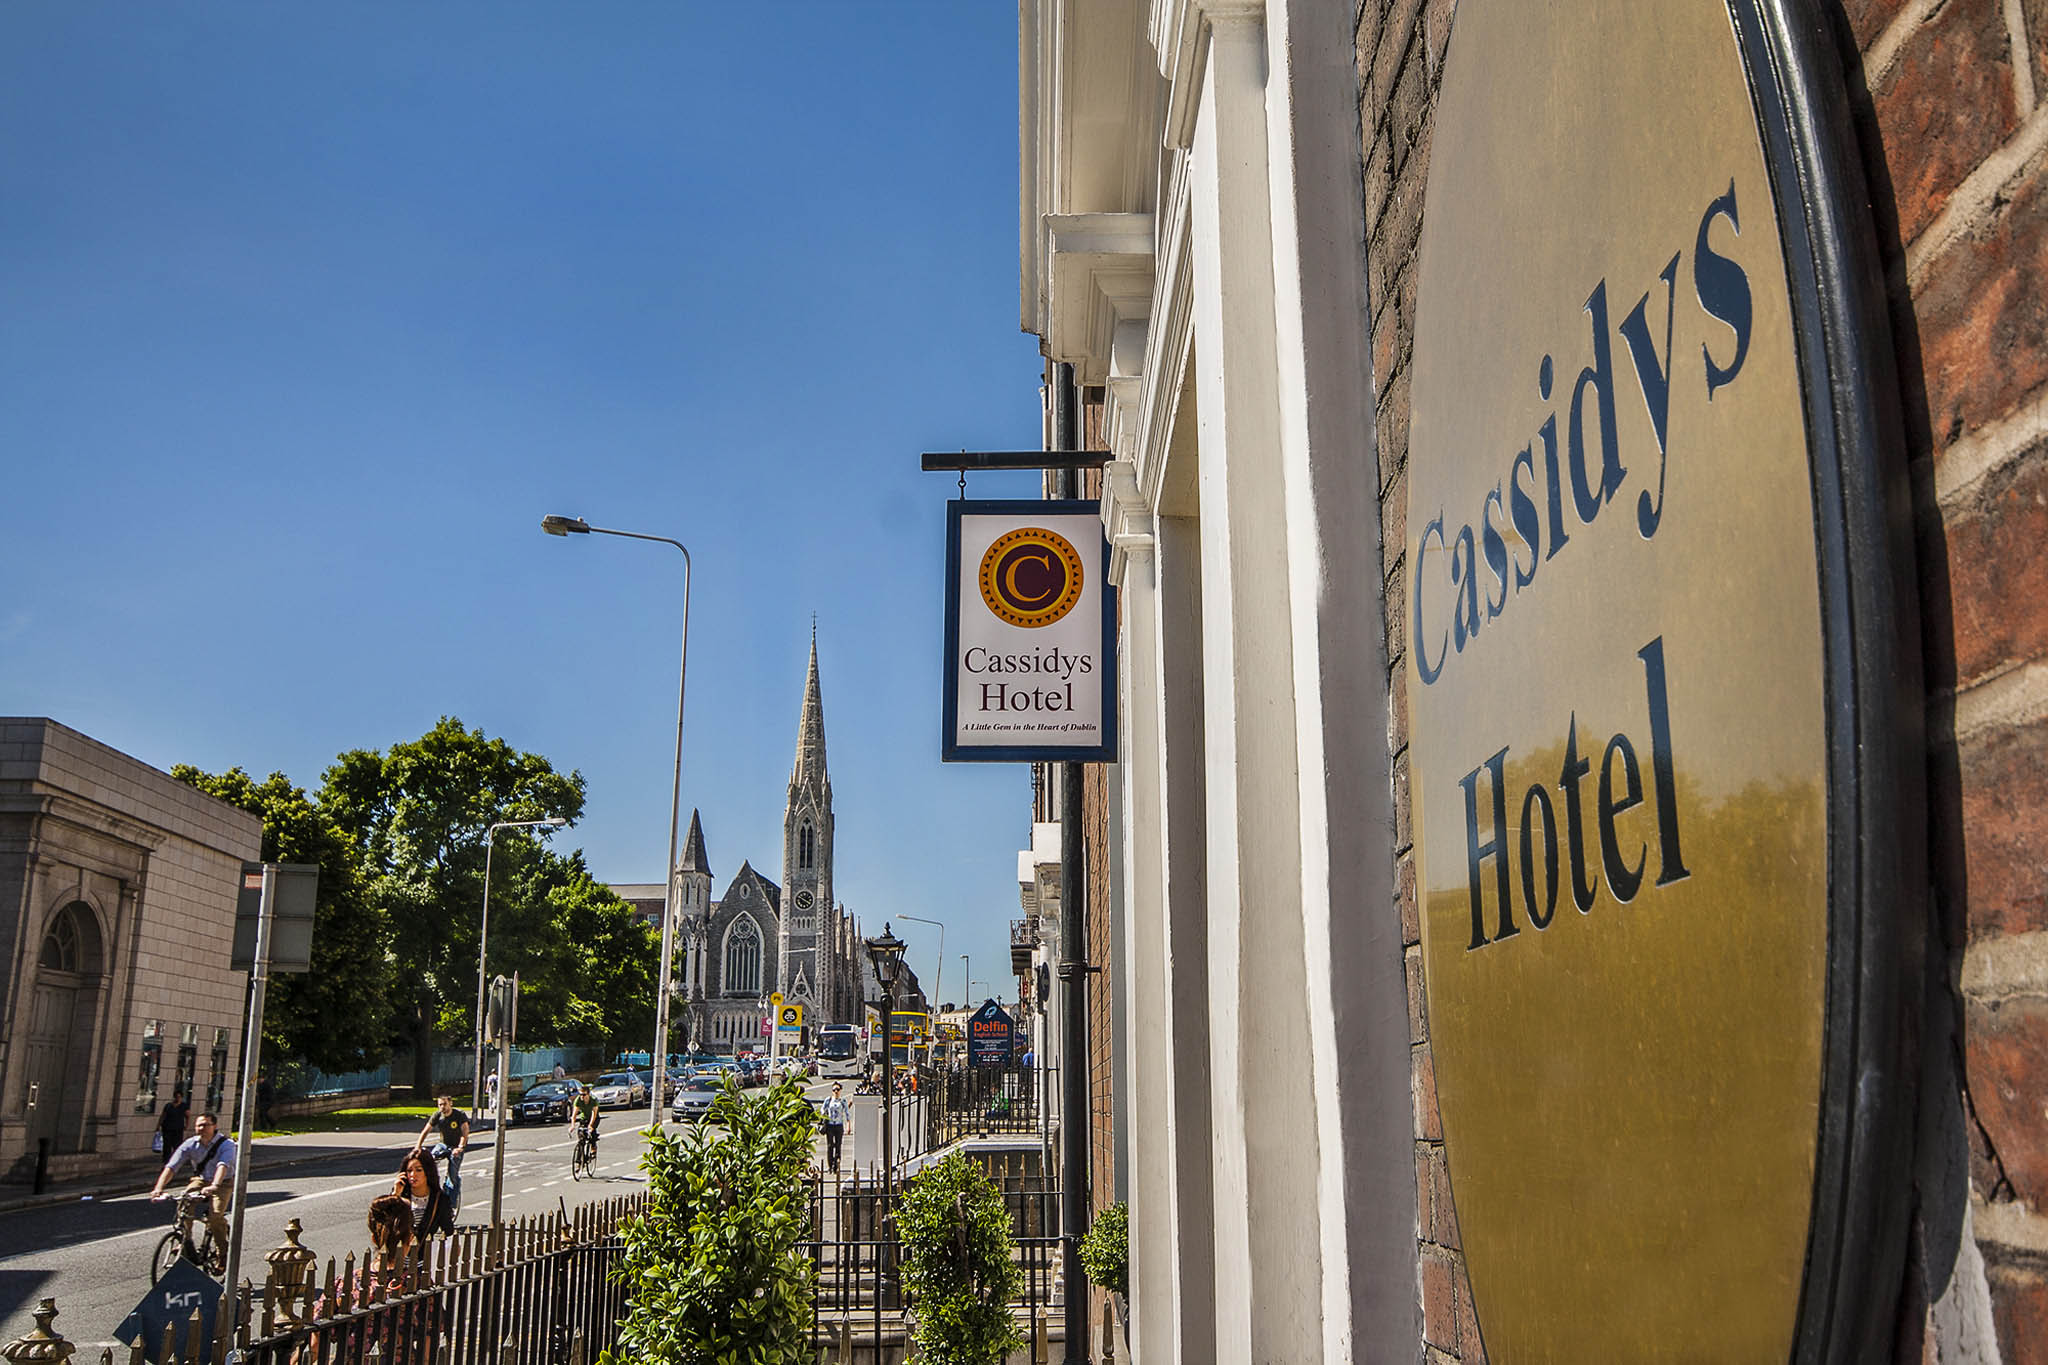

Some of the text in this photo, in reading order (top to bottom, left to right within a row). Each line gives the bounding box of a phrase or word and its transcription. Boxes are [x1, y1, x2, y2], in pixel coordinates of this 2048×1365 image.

[1412, 176, 1754, 686] Cassidys
[1005, 555, 1051, 602] C
[964, 647, 1093, 680] Cassidys
[978, 683, 1075, 712] Hotel
[962, 723, 1097, 733] A Little Gem in the Heart of Dublin
[1458, 635, 1692, 952] Hotel
[974, 1020, 1008, 1032] Delfin
